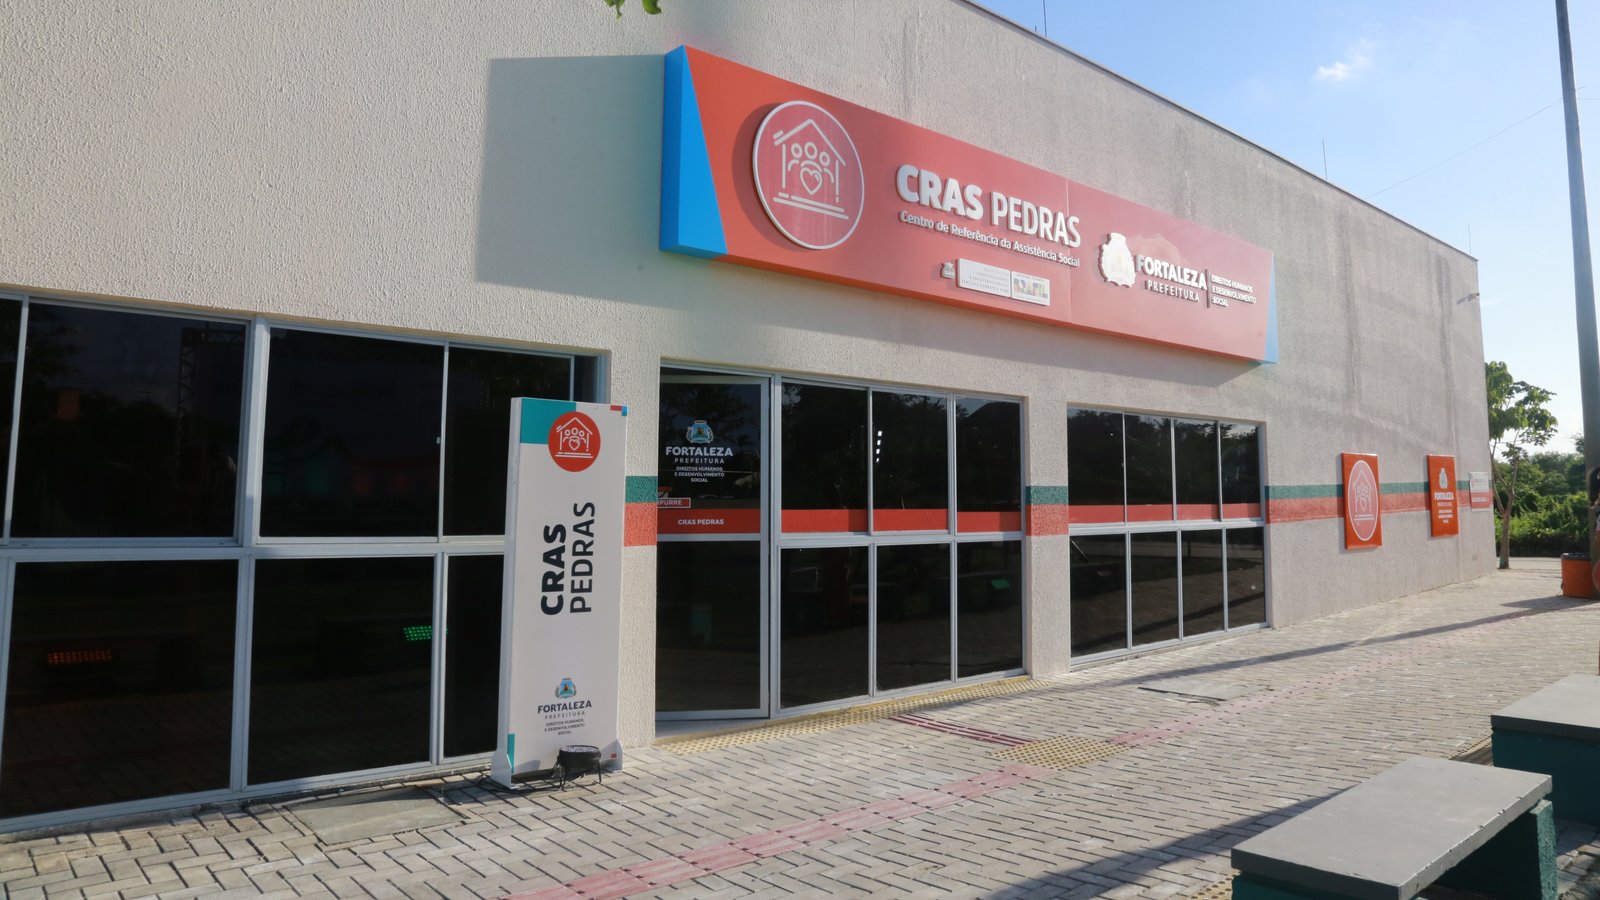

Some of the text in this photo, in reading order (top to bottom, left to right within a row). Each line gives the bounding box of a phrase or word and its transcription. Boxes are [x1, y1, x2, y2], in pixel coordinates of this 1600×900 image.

[896, 164, 1081, 248] CRAS PEDRAS
[899, 210, 1080, 267] Centro de Referência da Assistência Social
[1136, 254, 1208, 290] FORTALEZA
[1146, 279, 1200, 303] PREFEITURA
[665, 446, 733, 457] FORTALEZA
[540, 524, 566, 615] CRAS
[570, 502, 595, 613] PEDRAS
[537, 700, 592, 714] FORTALEZA
[544, 710, 585, 720] PREFEITURA
